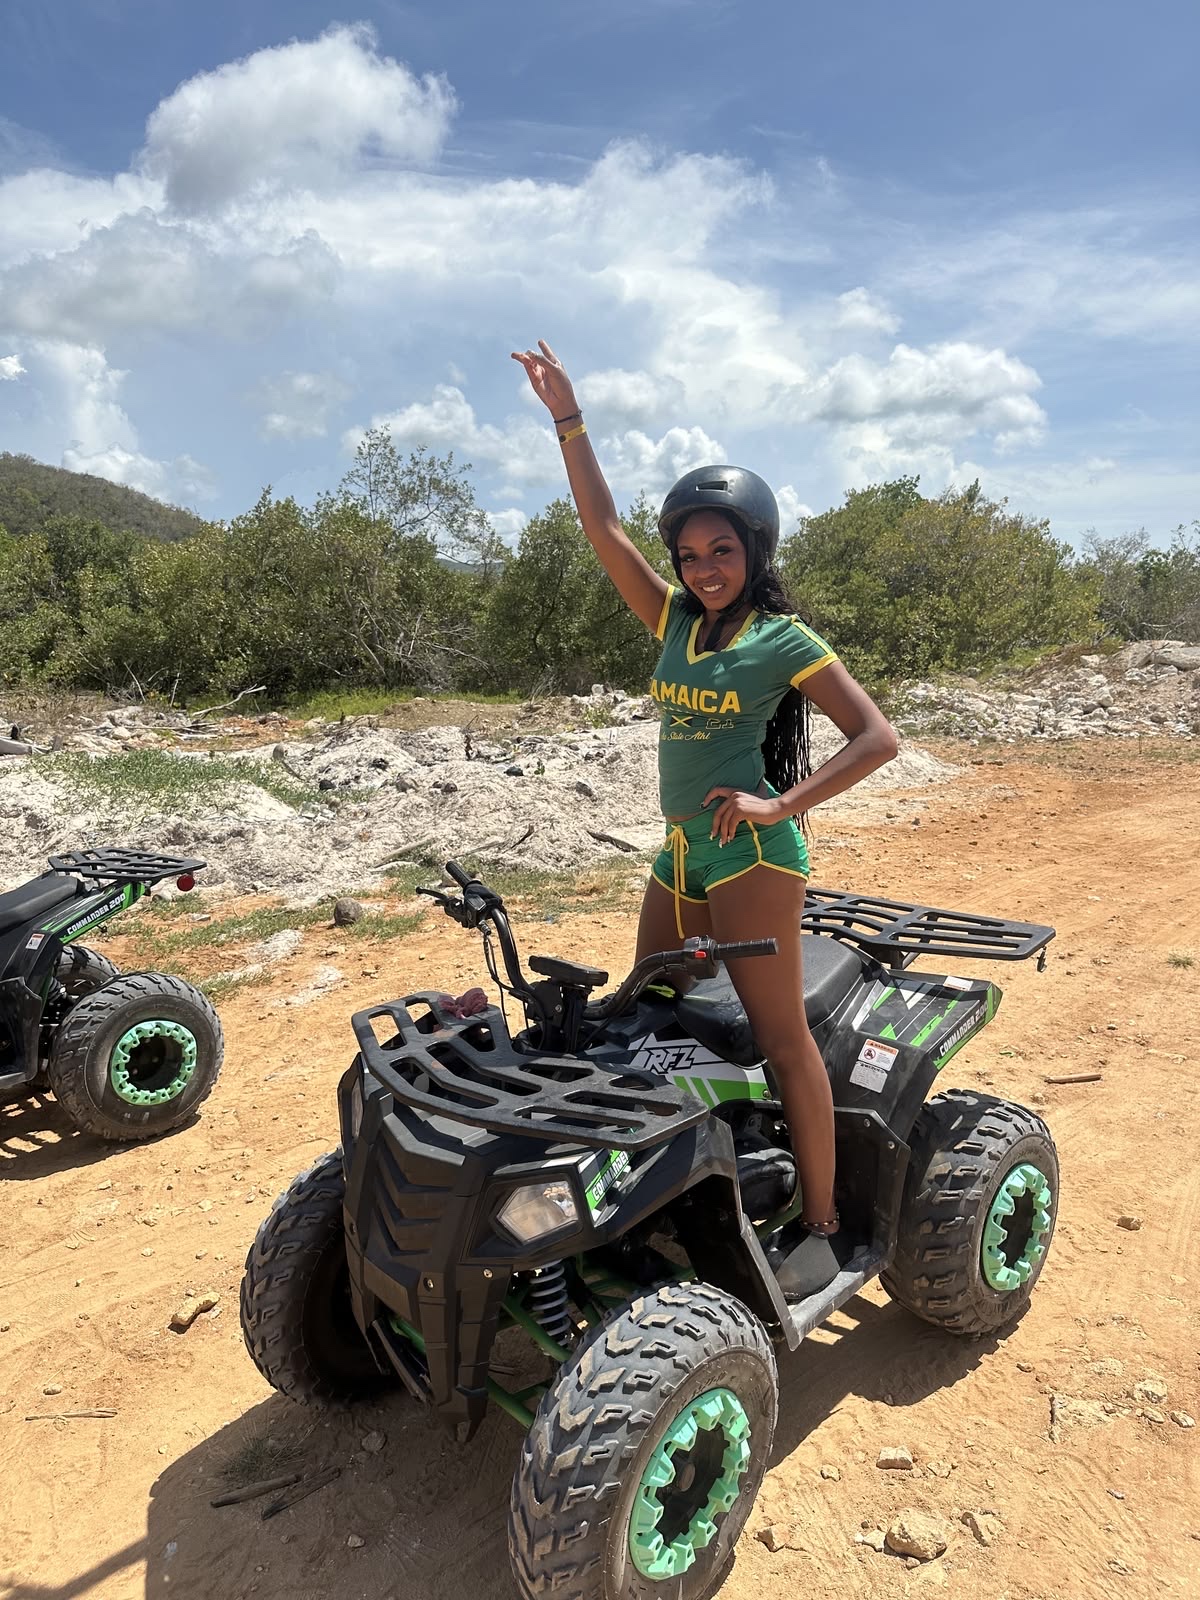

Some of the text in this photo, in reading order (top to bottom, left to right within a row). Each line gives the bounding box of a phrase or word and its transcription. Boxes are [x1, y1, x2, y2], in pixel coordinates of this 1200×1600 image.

[650, 679, 741, 714] AMAICA
[67, 892, 126, 935] COMMANDER 200
[940, 1015, 975, 1056] COMMANDER
